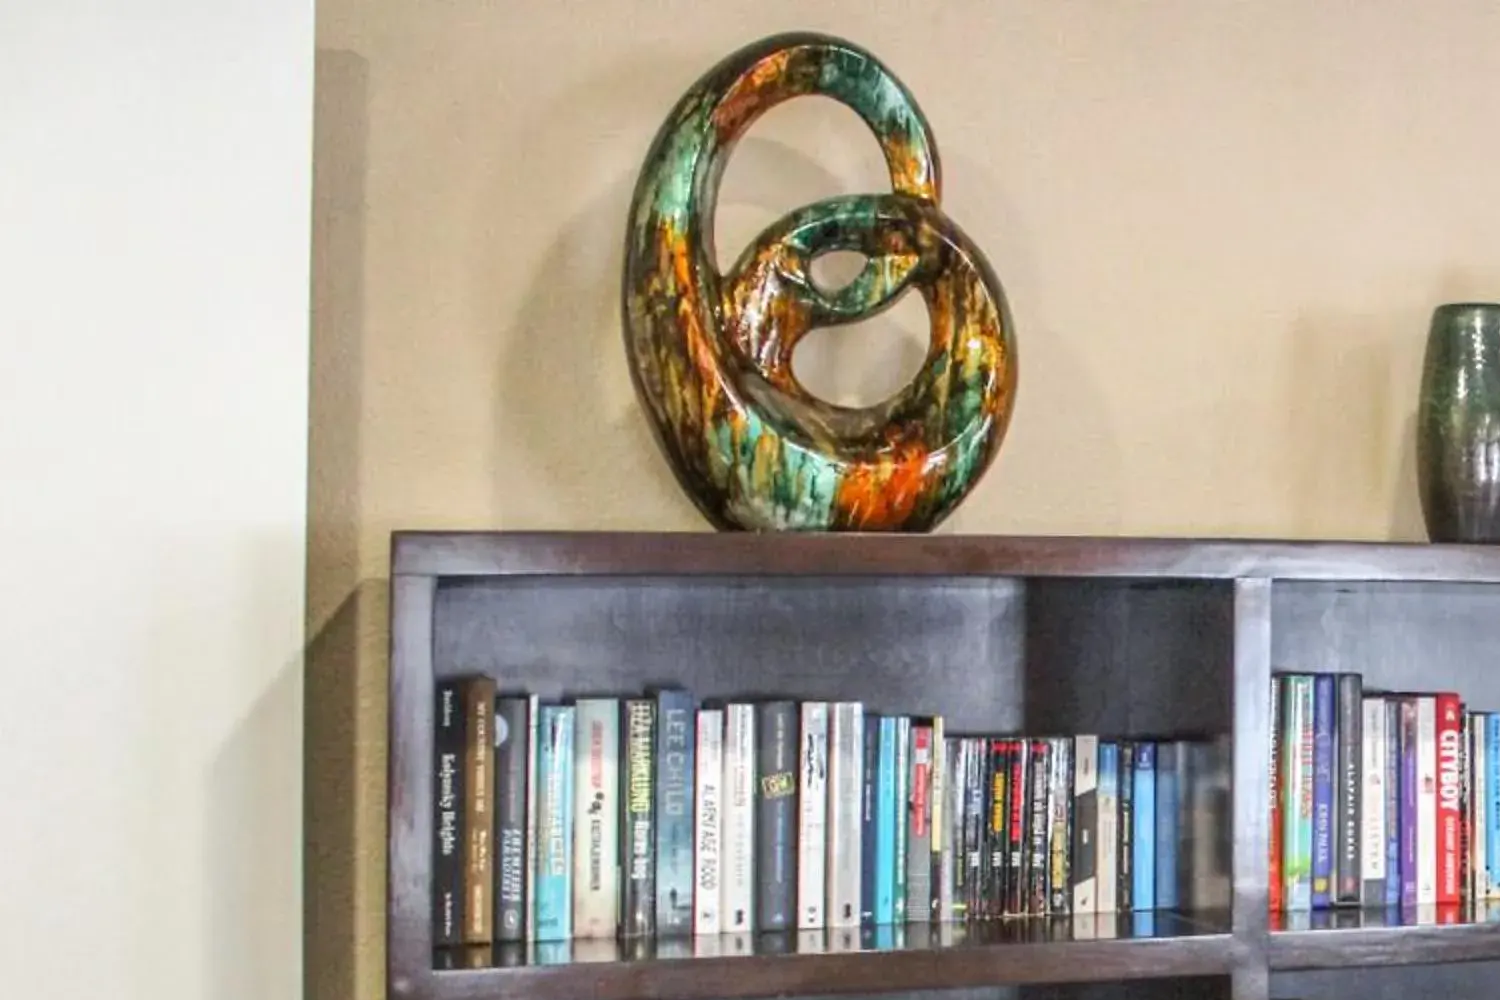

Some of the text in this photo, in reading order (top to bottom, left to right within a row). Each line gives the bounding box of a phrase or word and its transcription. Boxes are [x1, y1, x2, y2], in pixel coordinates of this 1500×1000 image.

[666, 709, 686, 815] LEE CHILD
[1439, 729, 1458, 811] CITYBOY
